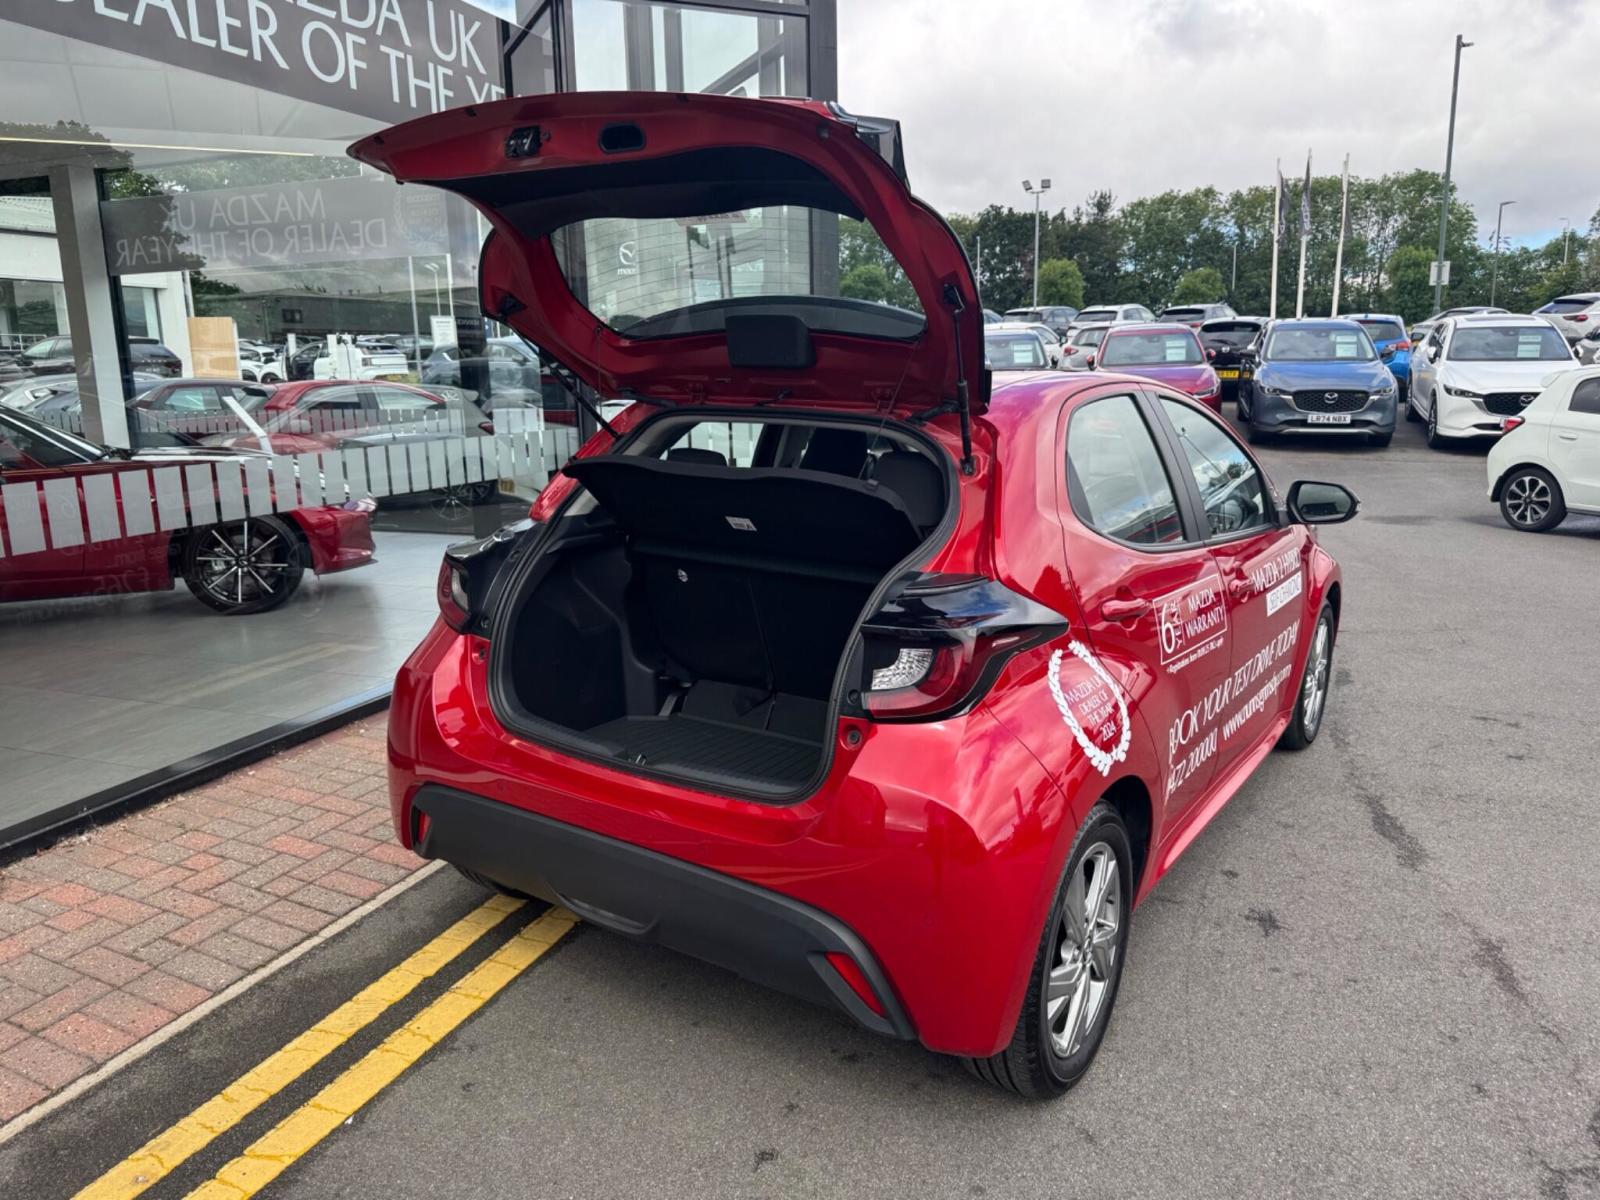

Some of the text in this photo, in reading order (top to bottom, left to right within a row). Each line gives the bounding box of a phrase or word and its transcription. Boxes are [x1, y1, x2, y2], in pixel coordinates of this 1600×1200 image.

[301, 20, 368, 91] OF
[427, 0, 486, 75] UK
[1184, 604, 1225, 639] WARRANTY
[1188, 586, 1216, 614] MAZDA
[1161, 603, 1176, 654] 6
[1168, 700, 1202, 765] BOOK
[1202, 677, 1232, 727] YOUR
[1231, 657, 1254, 700] TEST
[1250, 638, 1277, 683] DRIVE
[1273, 618, 1301, 661] TODAY
[1100, 719, 1117, 742] 2024
